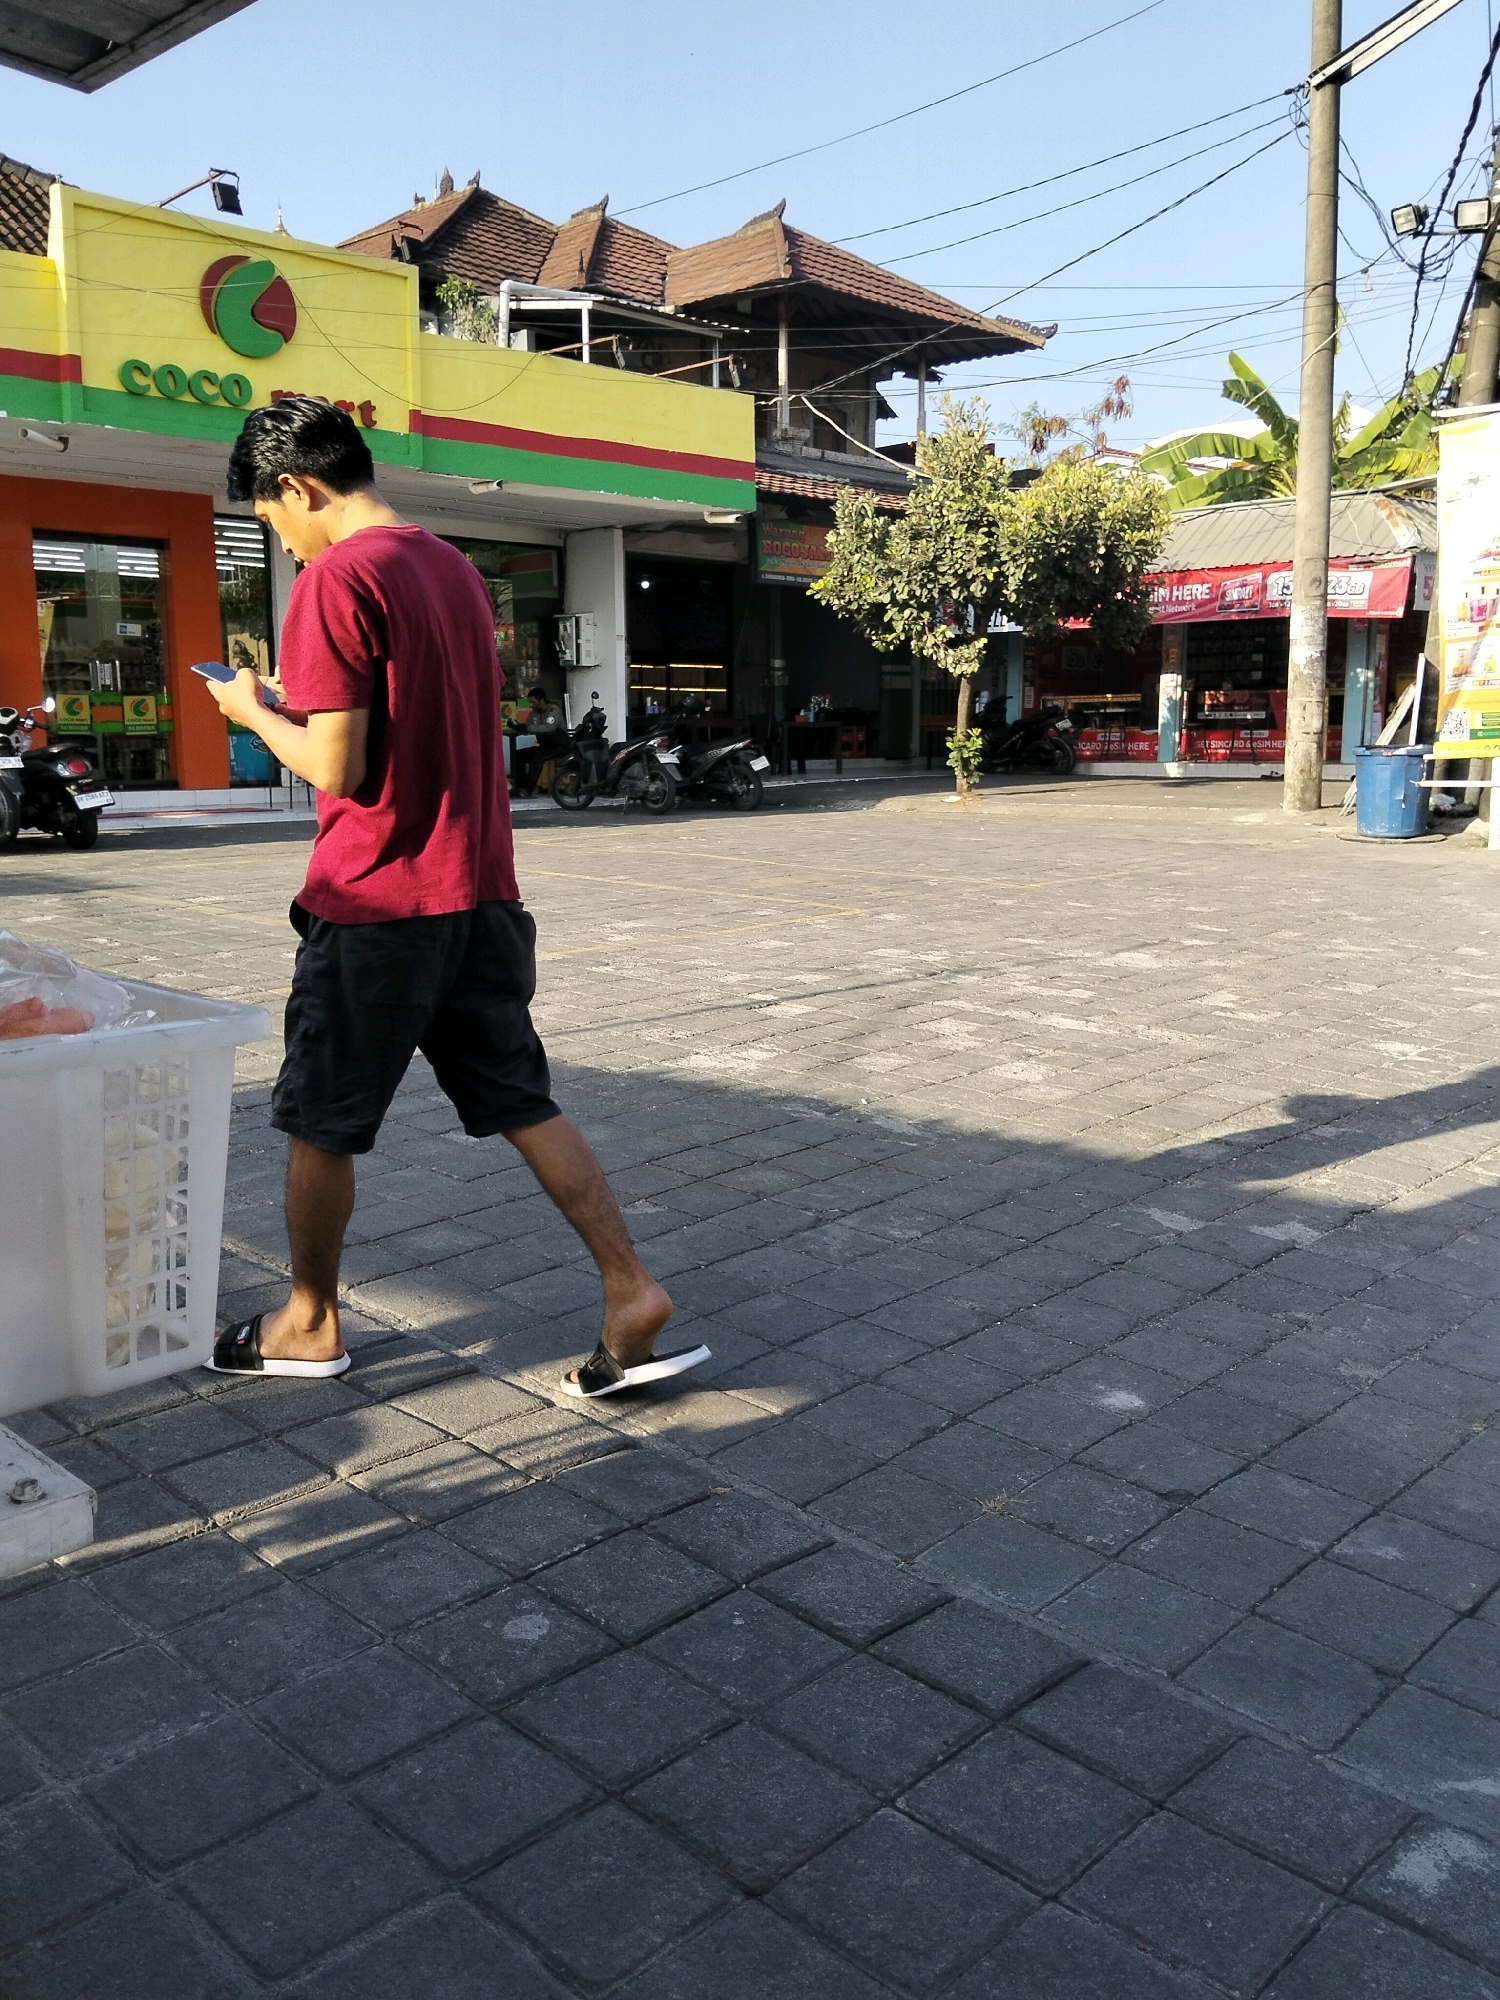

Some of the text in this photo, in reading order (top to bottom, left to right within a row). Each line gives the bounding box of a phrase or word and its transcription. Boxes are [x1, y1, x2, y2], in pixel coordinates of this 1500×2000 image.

[1171, 583, 1212, 602] HERE
[1422, 575, 1434, 601] 5
[1166, 603, 1197, 613] Network
[1128, 742, 1150, 750] HERE
